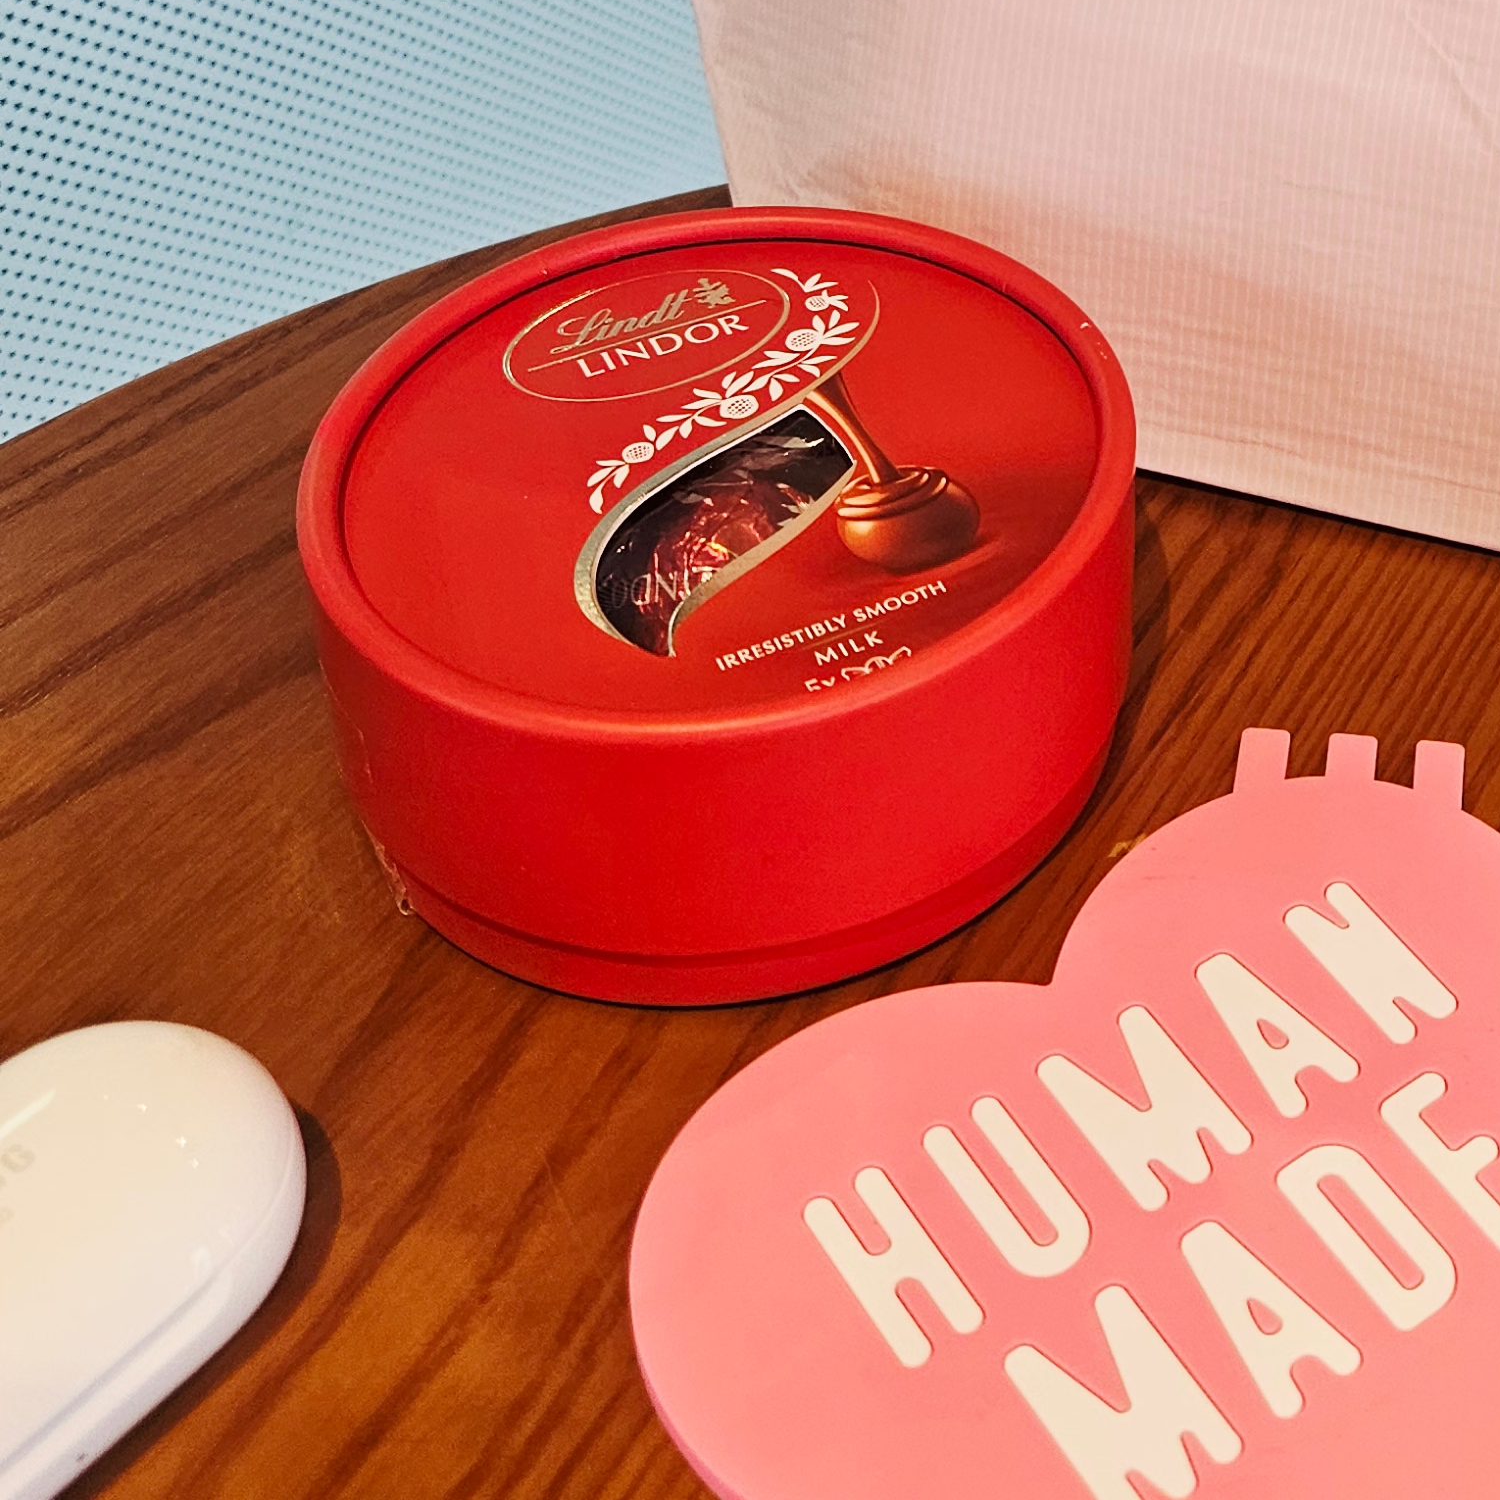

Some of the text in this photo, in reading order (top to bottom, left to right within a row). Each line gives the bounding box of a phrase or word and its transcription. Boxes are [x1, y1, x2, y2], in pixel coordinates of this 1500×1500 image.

[550, 289, 692, 354] Lindt
[577, 315, 749, 378] LINDOR
[715, 580, 947, 671] IRRESISTIBLY SMOOTH
[814, 630, 884, 666] MILK
[803, 881, 1459, 1368] HUMAN
